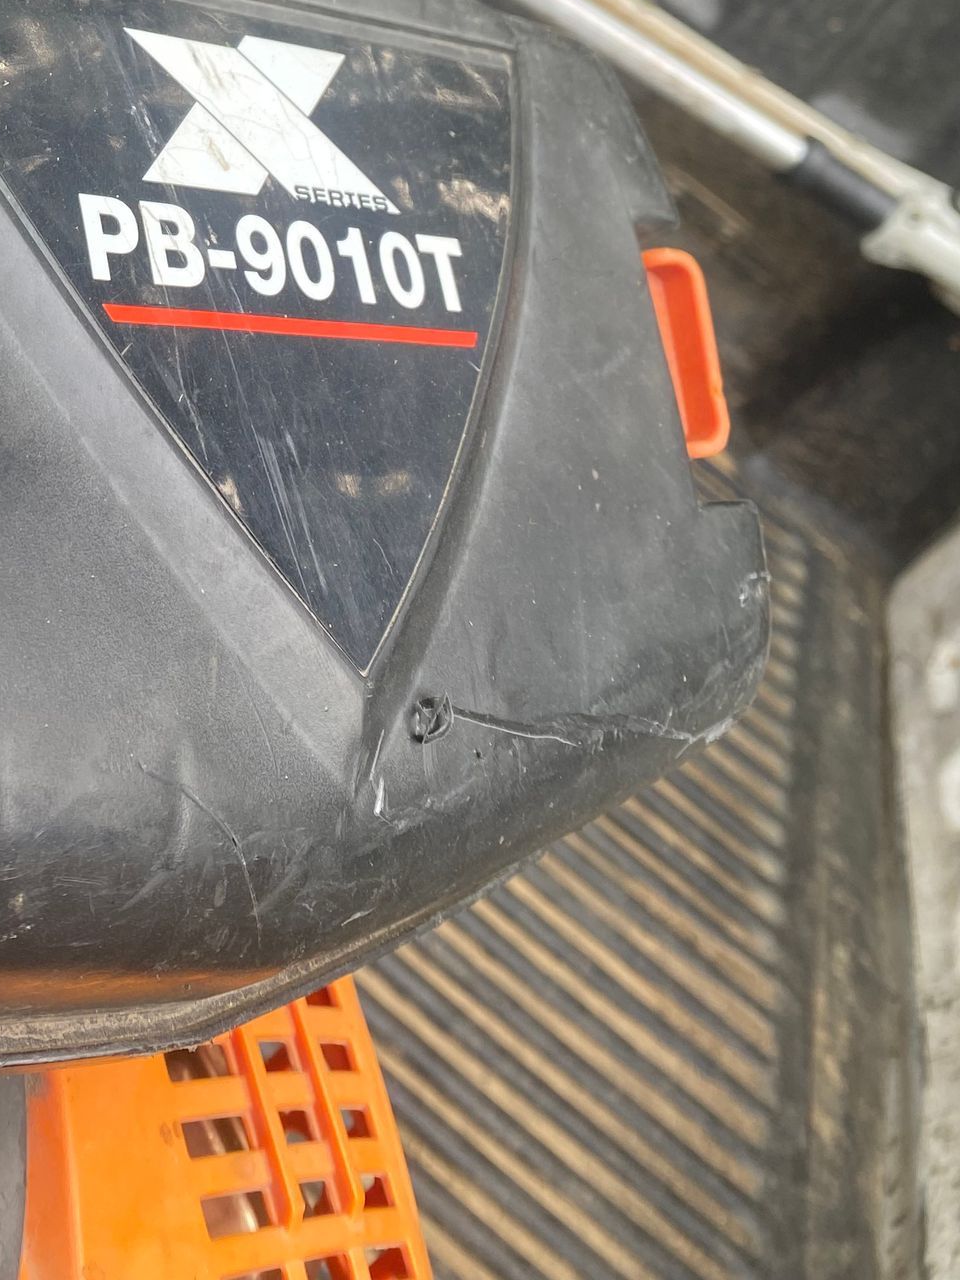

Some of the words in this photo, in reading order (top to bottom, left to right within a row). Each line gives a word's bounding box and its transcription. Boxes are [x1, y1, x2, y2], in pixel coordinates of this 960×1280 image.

[123, 27, 401, 215] X
[78, 192, 464, 313] PB-9010T
[294, 185, 388, 212] SERIES
